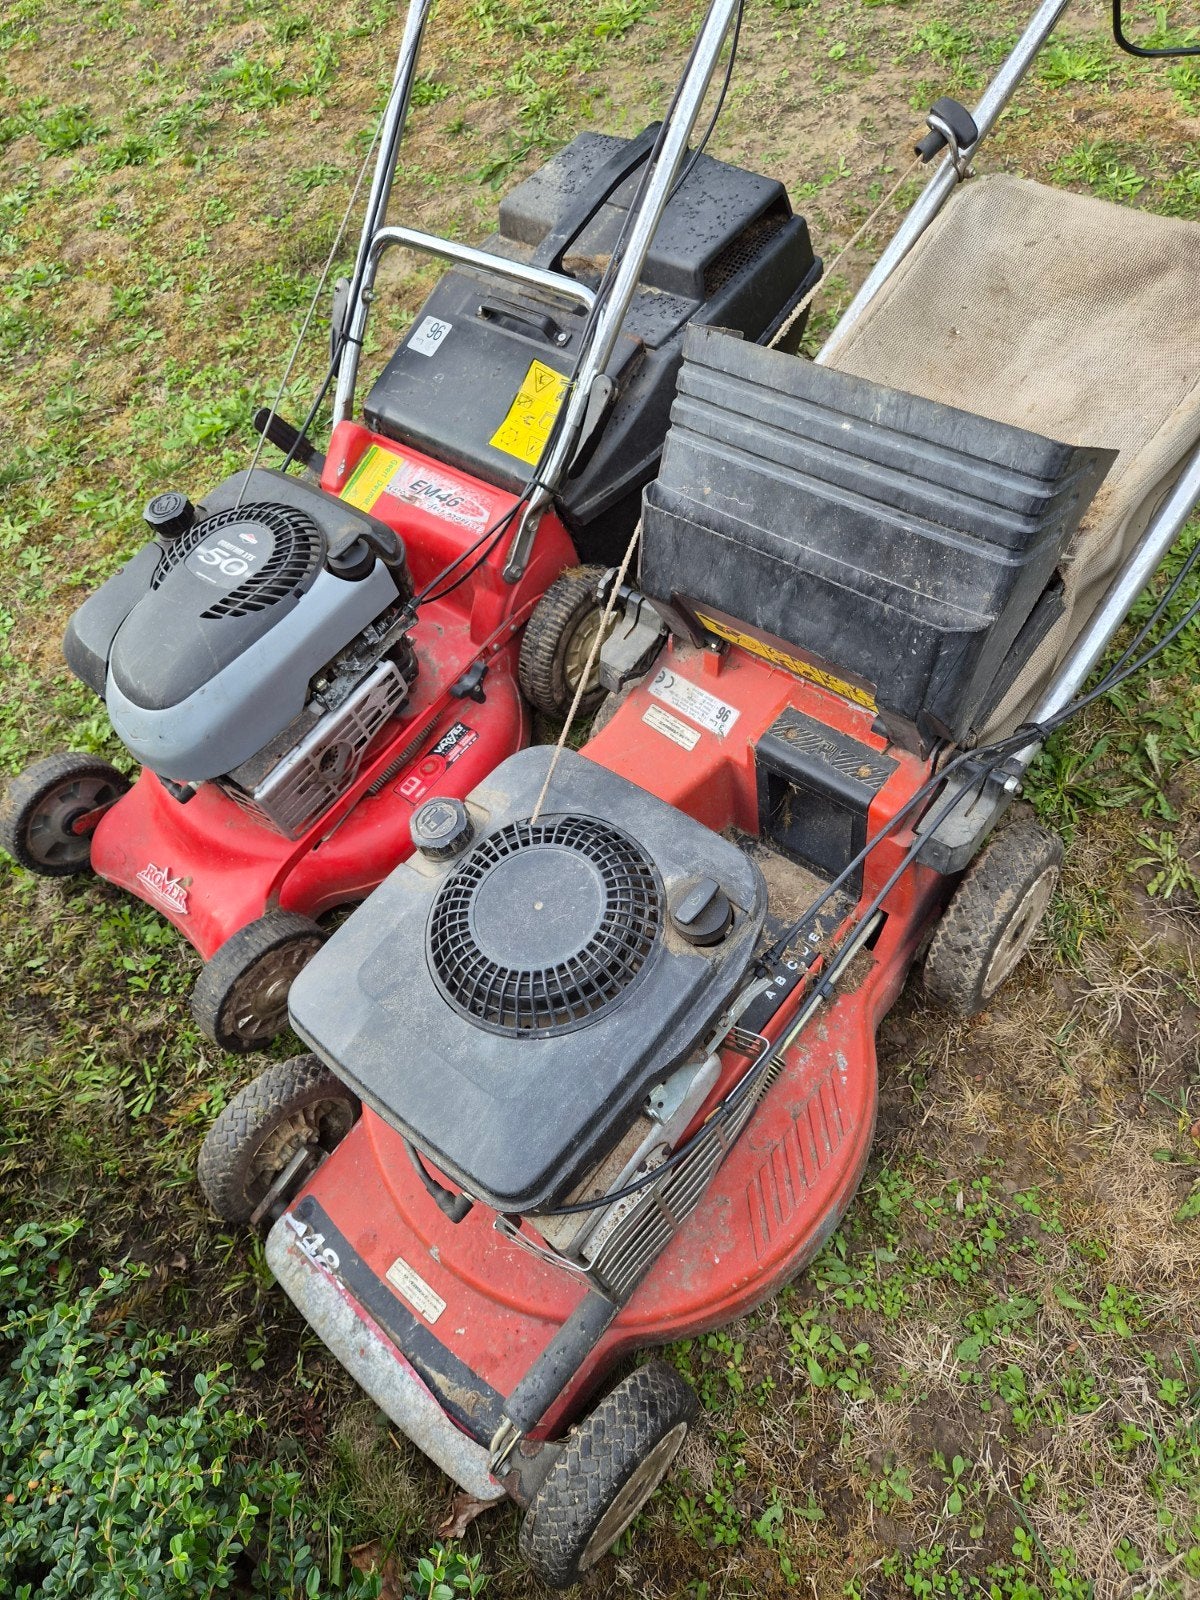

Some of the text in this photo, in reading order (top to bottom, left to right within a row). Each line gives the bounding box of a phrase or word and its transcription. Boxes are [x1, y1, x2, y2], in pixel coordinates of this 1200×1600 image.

[426, 322, 444, 341] 96
[409, 480, 465, 507] EM46
[197, 546, 249, 575] 50
[715, 705, 731, 722] 96
[139, 863, 187, 907] ROVER
[765, 990, 777, 1000] A
[774, 976, 787, 986] B
[787, 960, 798, 970] C
[808, 932, 820, 942] E
